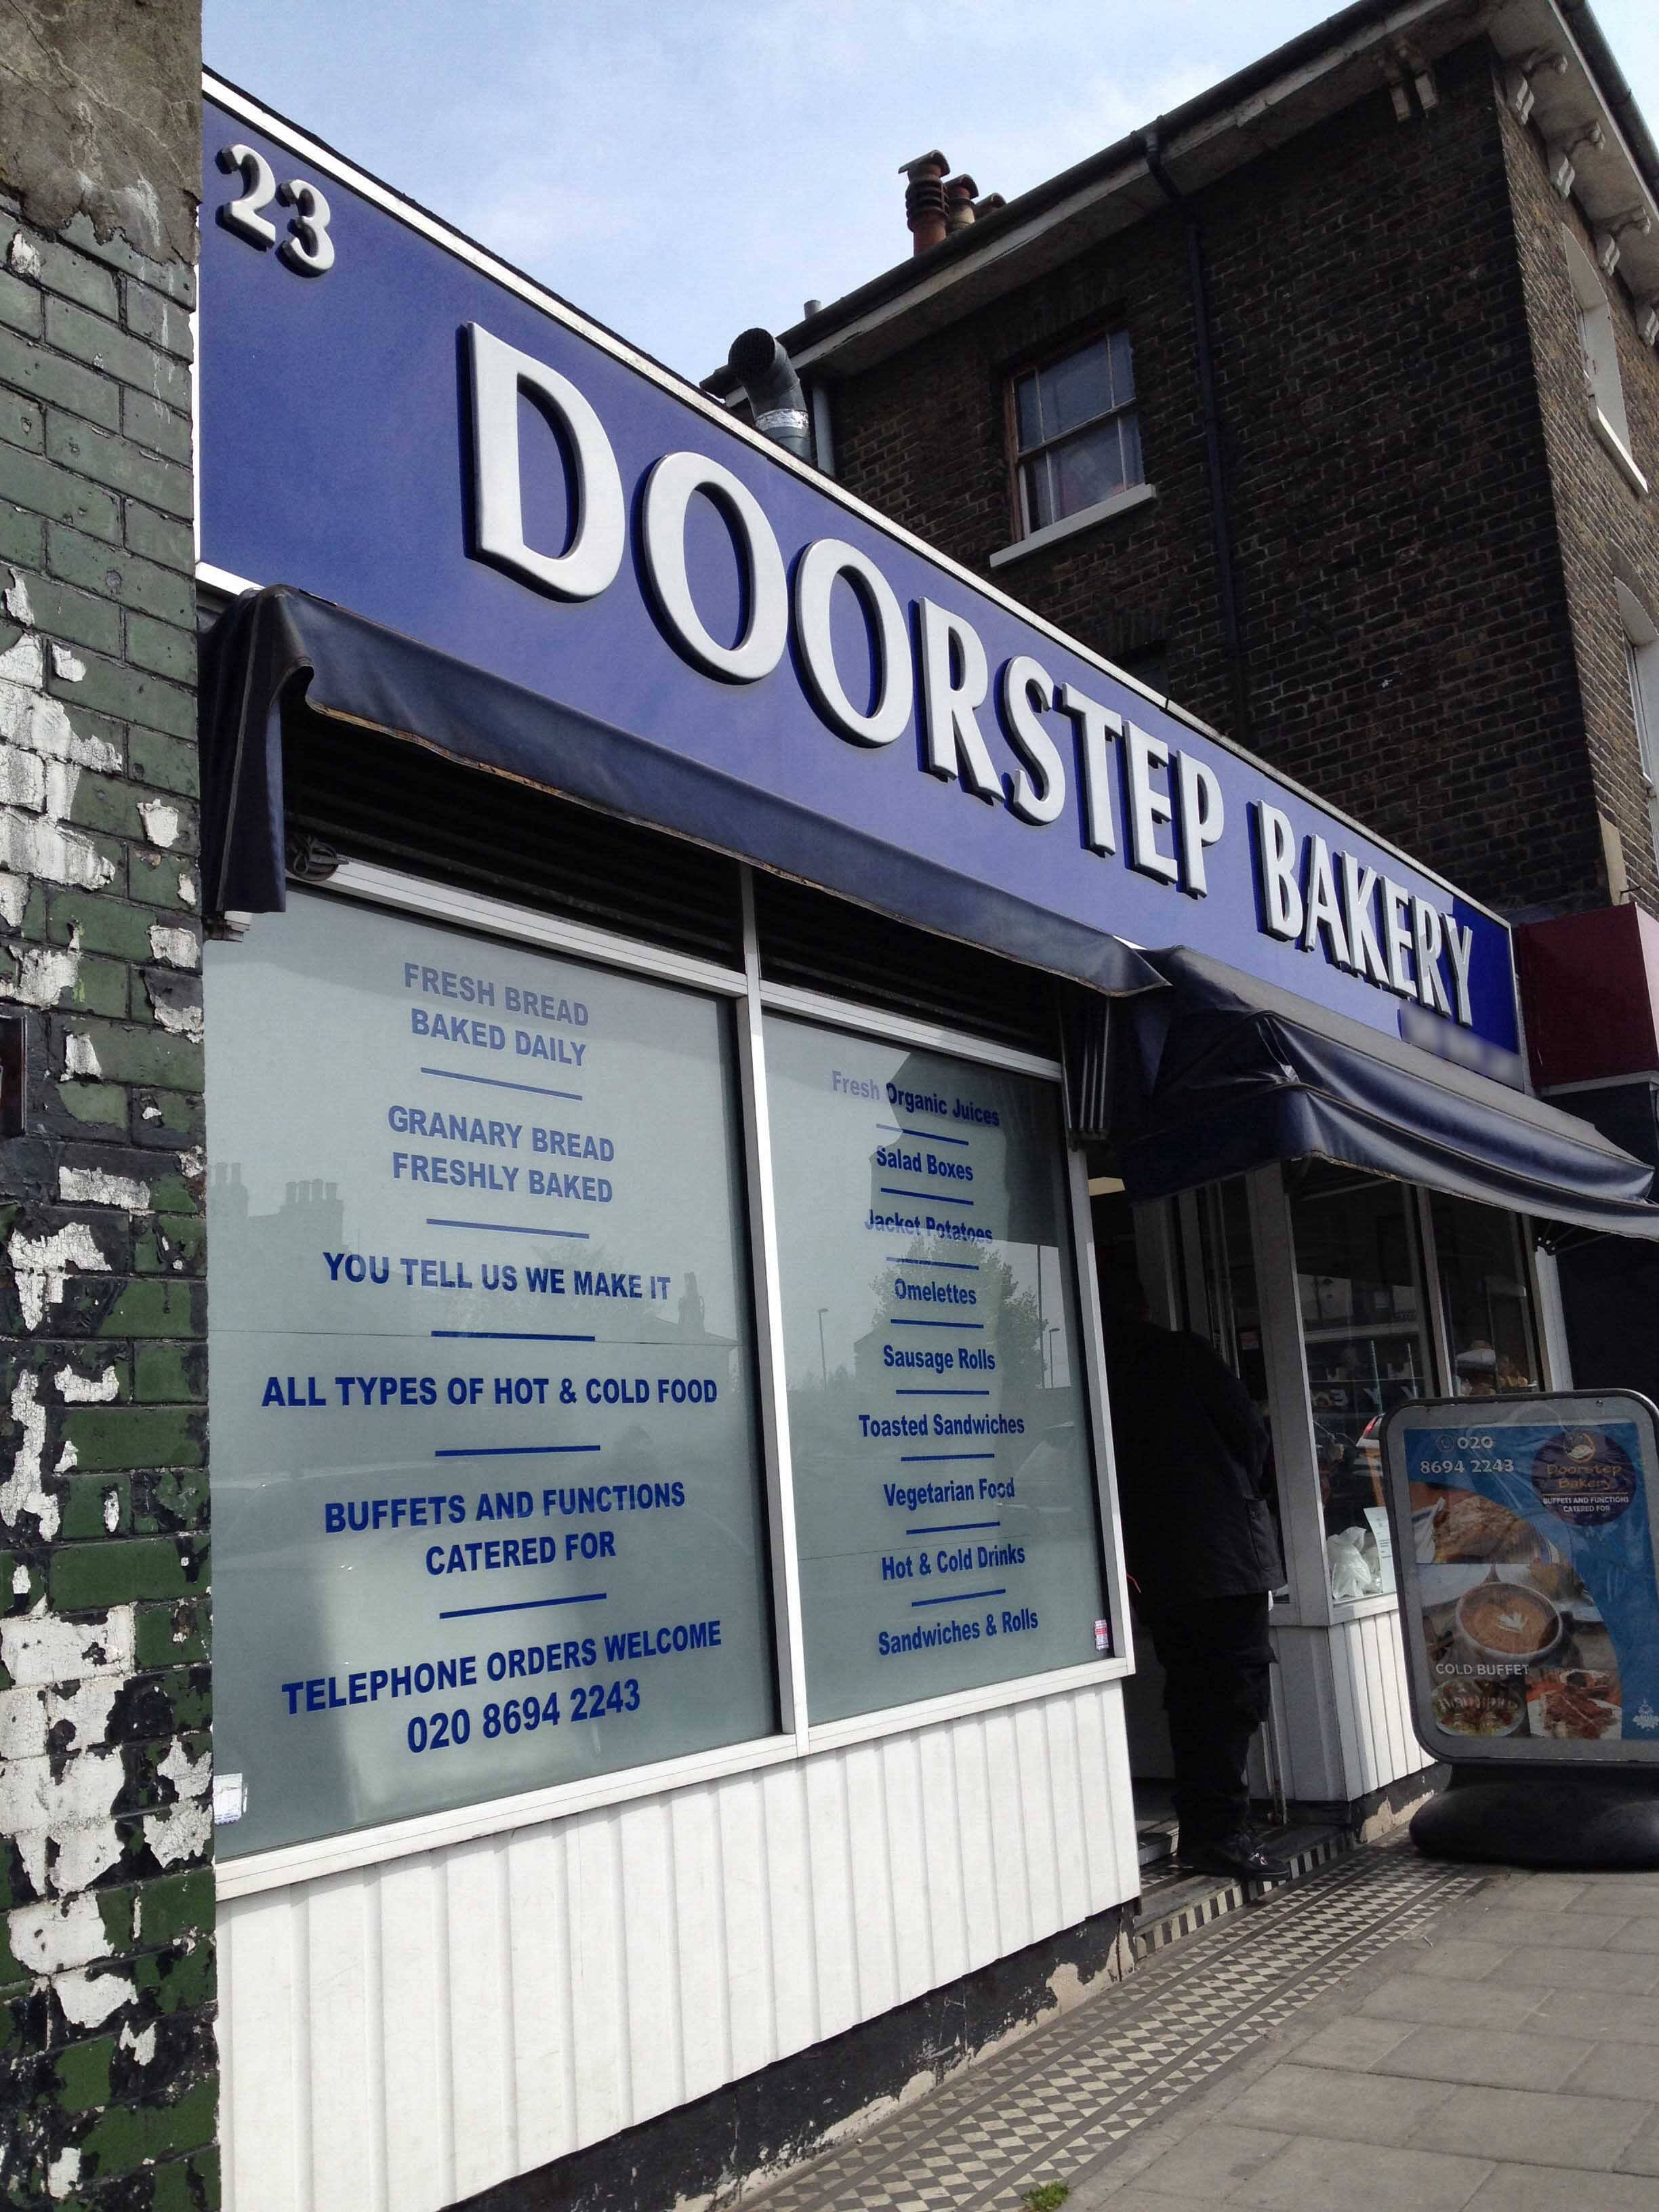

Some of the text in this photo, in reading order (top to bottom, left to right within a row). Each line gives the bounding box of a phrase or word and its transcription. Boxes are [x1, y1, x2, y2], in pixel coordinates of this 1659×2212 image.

[215, 142, 334, 277] 23
[457, 321, 1473, 1027] DOORSTEP BAKERY
[405, 962, 589, 1027] FRESH BREAD
[412, 1008, 586, 1066] BAKED DAILY
[832, 1070, 1000, 1126] Fresh Organic Juices
[388, 1105, 615, 1162] GRANARY BREAD
[392, 1153, 613, 1204] FRESHLY BAKED
[876, 1145, 973, 1181] Salad Boxes
[865, 1209, 993, 1244] Jacket Potatoes
[323, 1252, 671, 1300] YOU TELL US WE MAKE IT
[895, 1278, 977, 1305] Omelettes
[883, 1345, 996, 1374] Sausage Rolls
[262, 1377, 717, 1407] ALL TYPES OF HOT & COLD FOOD
[859, 1414, 1025, 1437] Toasted Sandwiches
[1457, 1436, 1495, 1450] 020
[1420, 1459, 1514, 1474] 8694 2243
[1547, 1464, 1622, 1476] Doorstep
[1559, 1477, 1610, 1490] Bakery
[325, 1482, 685, 1533] BUFFETS AND FUNCTIONS
[884, 1477, 1015, 1511] Vegetarian Food
[426, 1531, 616, 1576] CATERED FOR
[882, 1544, 1025, 1580] Hot & Cold Drinks
[879, 1608, 1038, 1656] Sandwiches & Rolls
[281, 1621, 722, 1715] TELEPHONE ORDERS WELCOME
[1436, 1663, 1529, 1675] COLD BUFFET
[407, 1679, 640, 1753] 020 8694 2243
